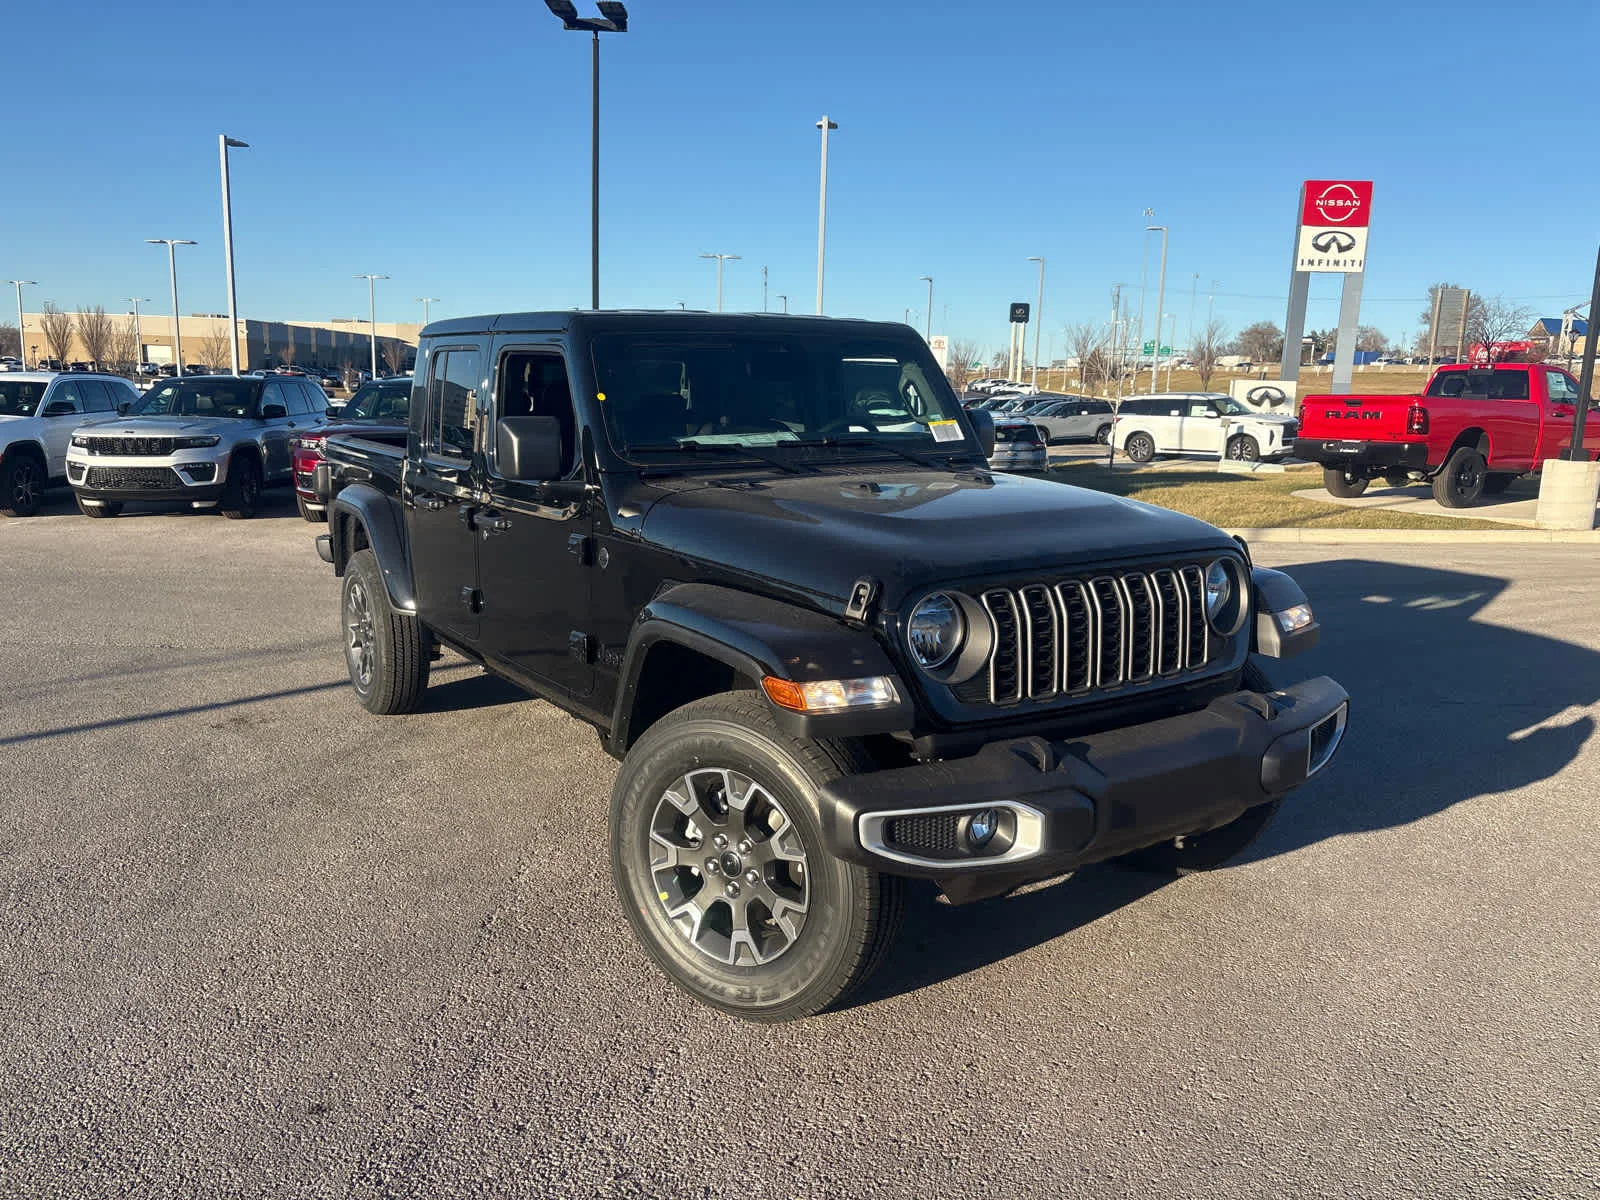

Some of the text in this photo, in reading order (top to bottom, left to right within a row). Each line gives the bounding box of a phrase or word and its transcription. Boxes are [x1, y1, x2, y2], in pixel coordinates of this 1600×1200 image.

[1315, 199, 1361, 207] NISSAN
[1300, 258, 1363, 267] INFINITI
[1325, 410, 1383, 420] RAM
